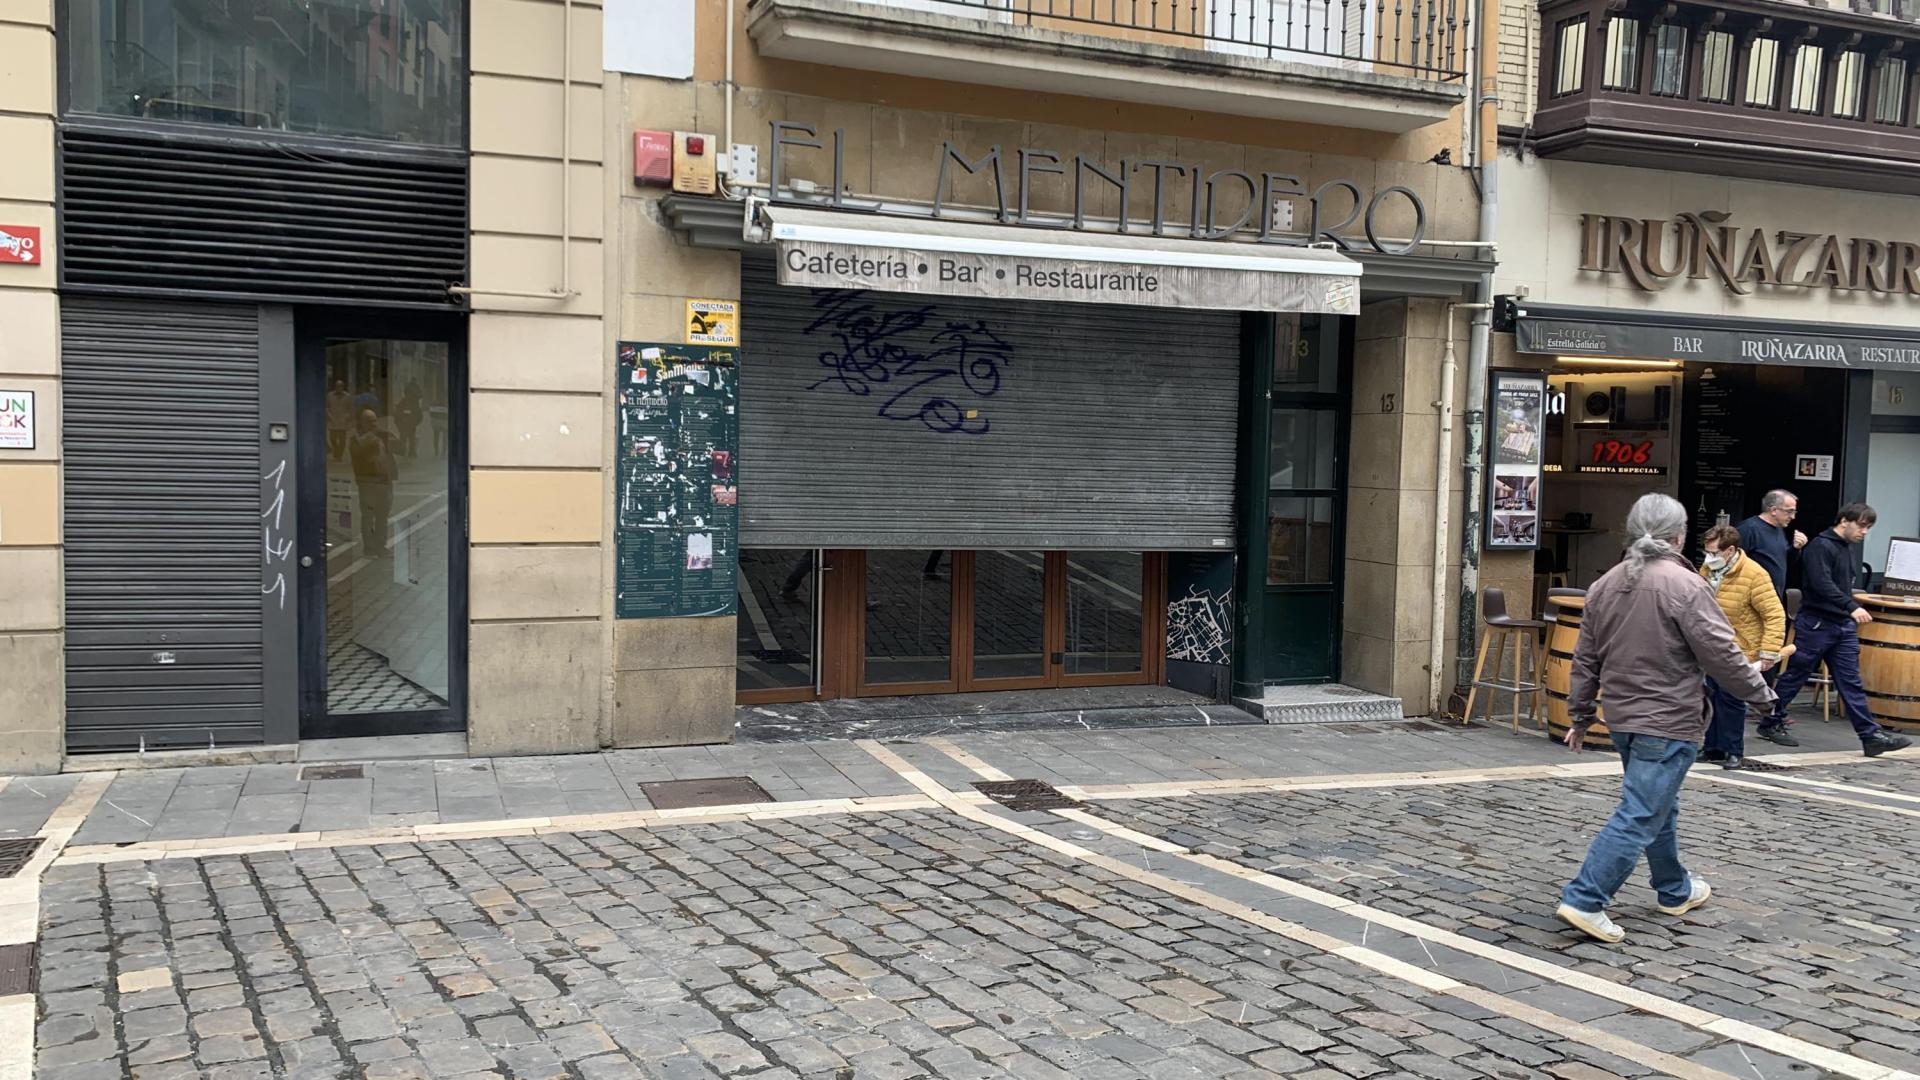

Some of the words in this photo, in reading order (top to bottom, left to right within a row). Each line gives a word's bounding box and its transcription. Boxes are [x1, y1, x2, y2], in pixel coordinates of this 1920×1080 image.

[769, 121, 881, 212] EL
[929, 140, 1426, 255] MENTIDERO
[1576, 210, 1920, 295] IRUÑAZARR
[786, 249, 908, 278] Cafetería
[938, 259, 983, 283] Bar
[1015, 264, 1158, 292] Restaurante
[1547, 338, 1574, 349] Estrella
[1575, 340, 1599, 349] Galicia
[1673, 336, 1703, 353] BAR
[1741, 338, 1851, 366] IRUÑAZARRA
[1860, 346, 1920, 364] RESTAUR
[1381, 393, 1395, 412] 13
[1592, 440, 1653, 464] 1906
